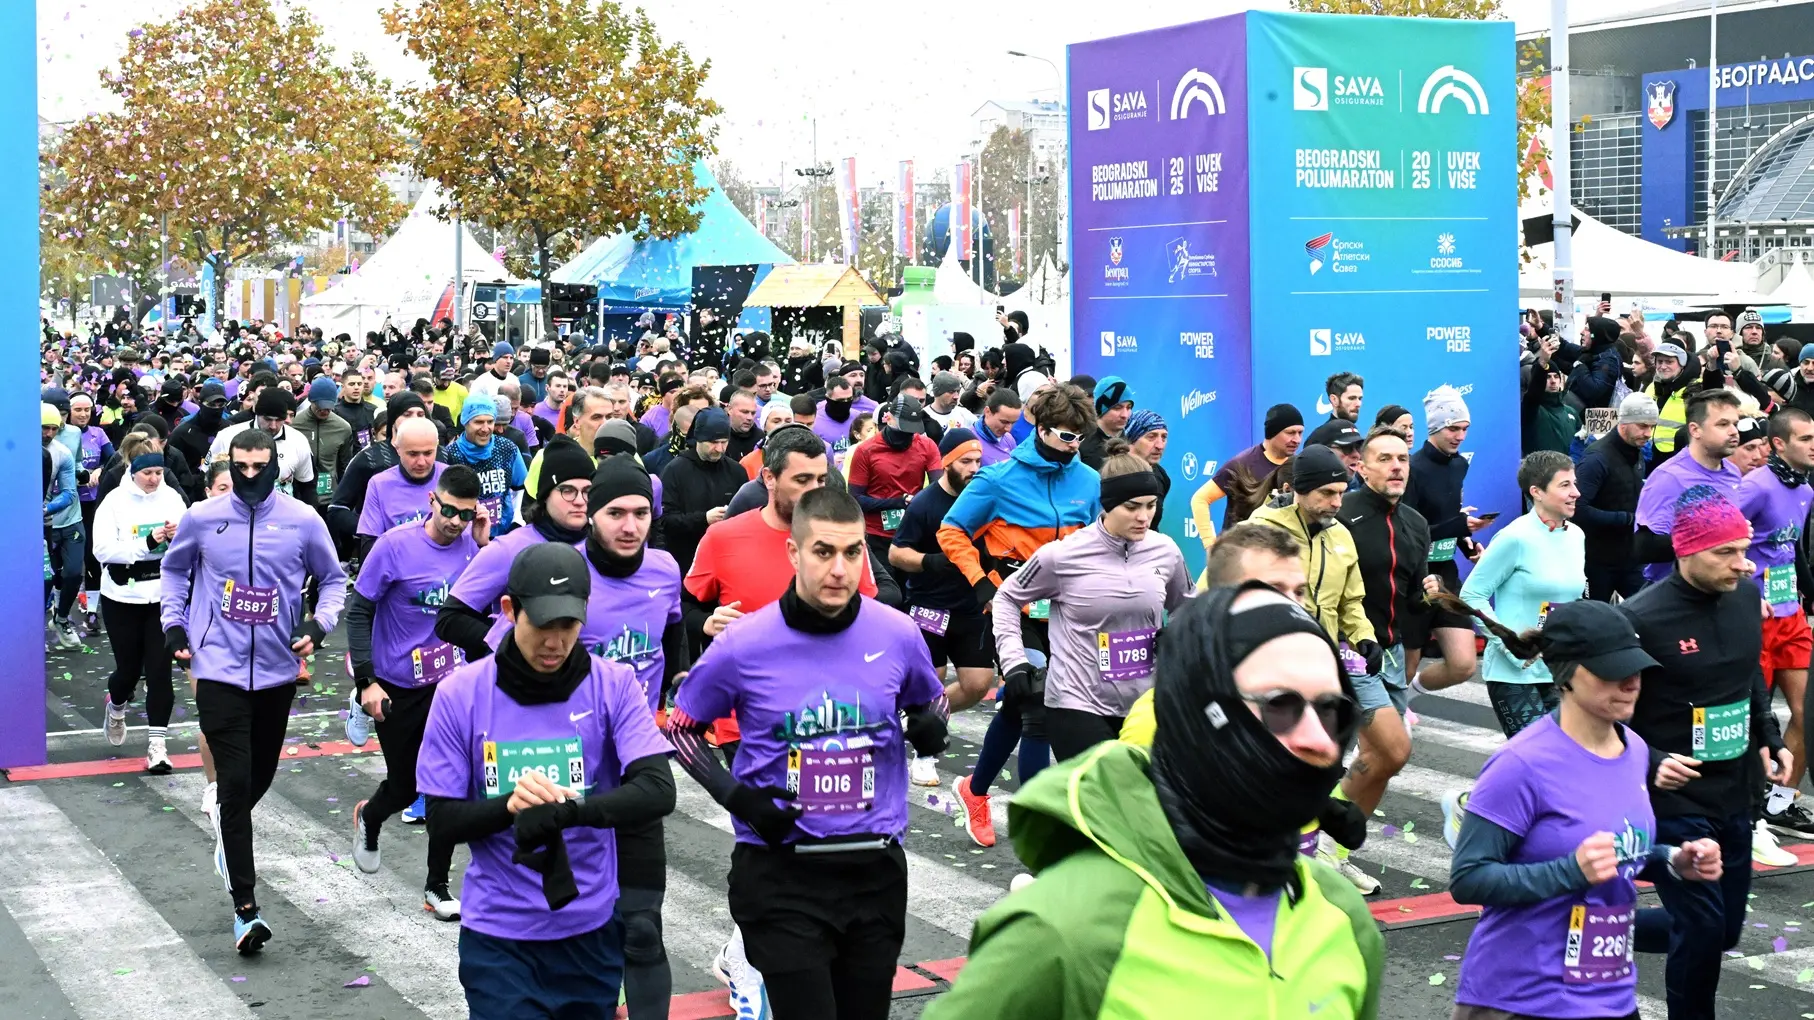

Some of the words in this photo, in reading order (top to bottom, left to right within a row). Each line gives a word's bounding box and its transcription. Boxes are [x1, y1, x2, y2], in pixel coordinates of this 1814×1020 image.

[1334, 75, 1384, 97] SAVA
[1113, 90, 1147, 112] SAVA
[1334, 97, 1384, 106] OSIGURANJE
[1113, 110, 1147, 121] OSIGURANJE
[1295, 149, 1380, 168] BEOGRADSKI
[1411, 151, 1431, 170] 20
[1447, 151, 1481, 171] UVEK
[1092, 160, 1148, 183] BEOGRADSKI
[1170, 156, 1184, 176] 20
[1195, 152, 1222, 174] UVEK
[1296, 169, 1394, 188] POLUMARATON
[1412, 170, 1431, 189] 25
[1448, 169, 1477, 189] VIŠE
[1092, 178, 1158, 201] POLUMARATON
[1170, 176, 1184, 195] 25
[1196, 172, 1218, 193] VIŠE
[1332, 238, 1363, 252] Српски
[1332, 250, 1371, 262] Атлетски
[1430, 257, 1463, 269] ССОСИБ
[1332, 262, 1358, 273] Савез
[1180, 332, 1214, 345] POWER
[1334, 332, 1366, 346] SAVA
[1427, 326, 1471, 340] POWER
[1116, 335, 1138, 348] SAVA
[1447, 339, 1471, 353] ADE
[1195, 345, 1214, 359] ADE
[1180, 388, 1217, 419] Wellness
[477, 468, 506, 483] WER
[1437, 542, 1456, 551] 4922
[235, 599, 268, 613] 2587
[916, 606, 942, 622] 2827
[433, 655, 446, 669] 60
[1117, 647, 1148, 664] 1789
[1711, 722, 1744, 742] 5058
[564, 743, 579, 753] 10K
[487, 751, 494, 761] A
[813, 774, 852, 794] 1016
